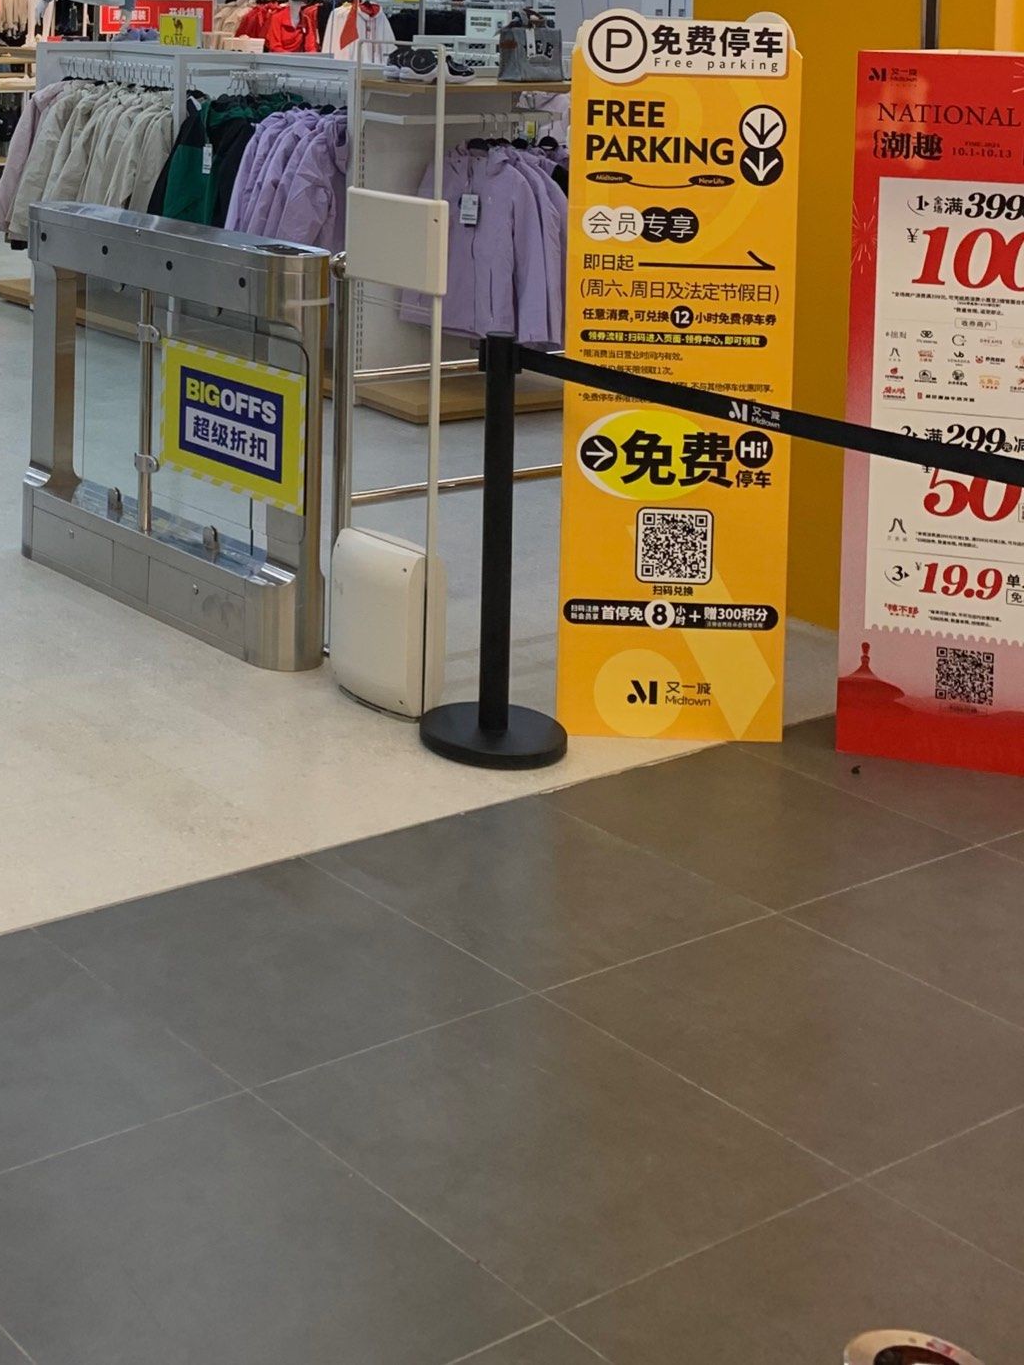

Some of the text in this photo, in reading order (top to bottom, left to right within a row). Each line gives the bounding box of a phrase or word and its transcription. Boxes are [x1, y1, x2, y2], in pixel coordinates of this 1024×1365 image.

[163, 36, 191, 46] CAMEL
[651, 24, 784, 59] 免费停车
[654, 57, 779, 73] Free parking
[586, 99, 666, 128] FREE
[877, 101, 1022, 128] NATIONAL
[585, 134, 735, 166] PARKING
[587, 211, 695, 239] 会员专享
[583, 253, 634, 271] 即日起
[186, 377, 277, 425] BIGOFFS
[192, 415, 269, 462] 超级折扣
[739, 440, 769, 460] Hi!
[620, 429, 734, 489] 免费
[735, 469, 773, 489] 停车
[652, 585, 694, 597] 扫码兑换
[665, 681, 712, 695] 又一城
[665, 695, 712, 707] Midtown
